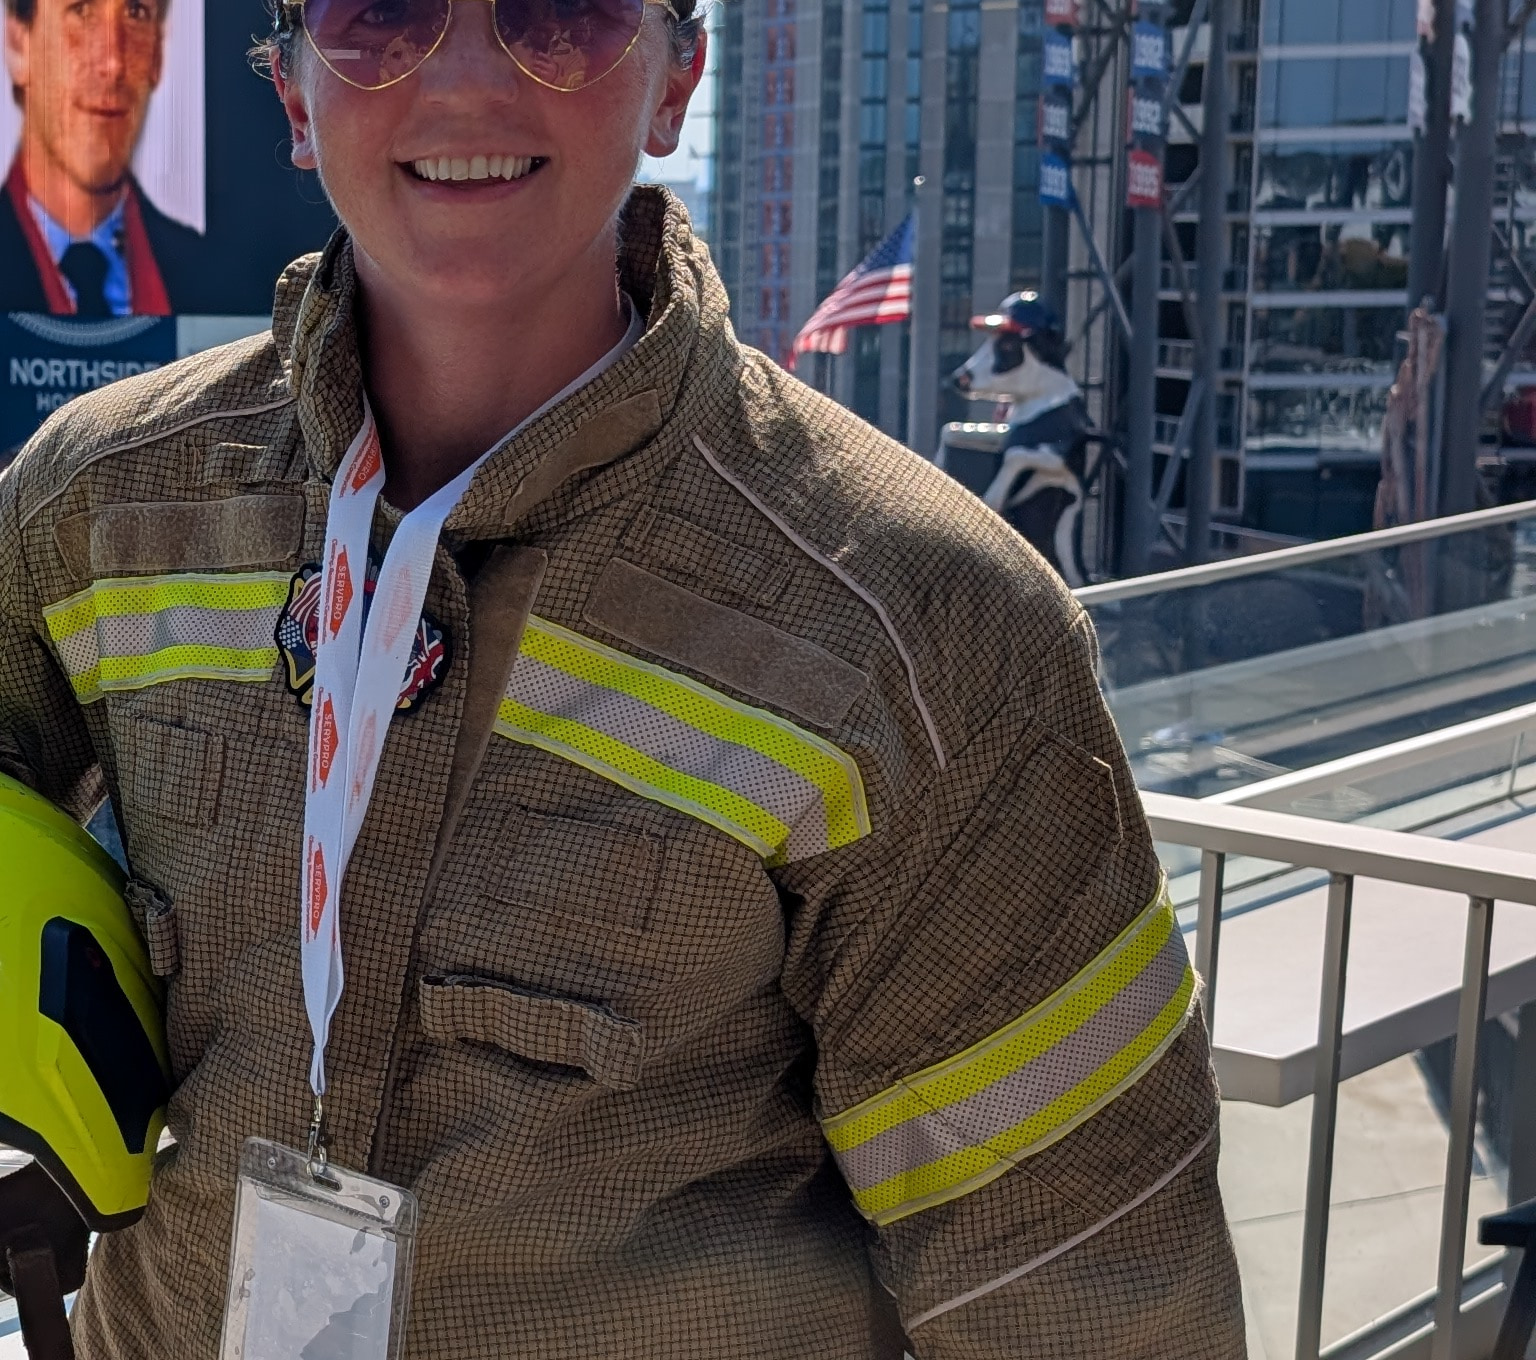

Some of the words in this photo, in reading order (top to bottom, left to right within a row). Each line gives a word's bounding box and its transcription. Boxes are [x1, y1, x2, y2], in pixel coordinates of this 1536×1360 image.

[9, 357, 161, 390] NORTHSID
[333, 565, 347, 621] SERVPRO
[320, 712, 332, 770] SERVPRO
[313, 863, 323, 921] SERVPRO
